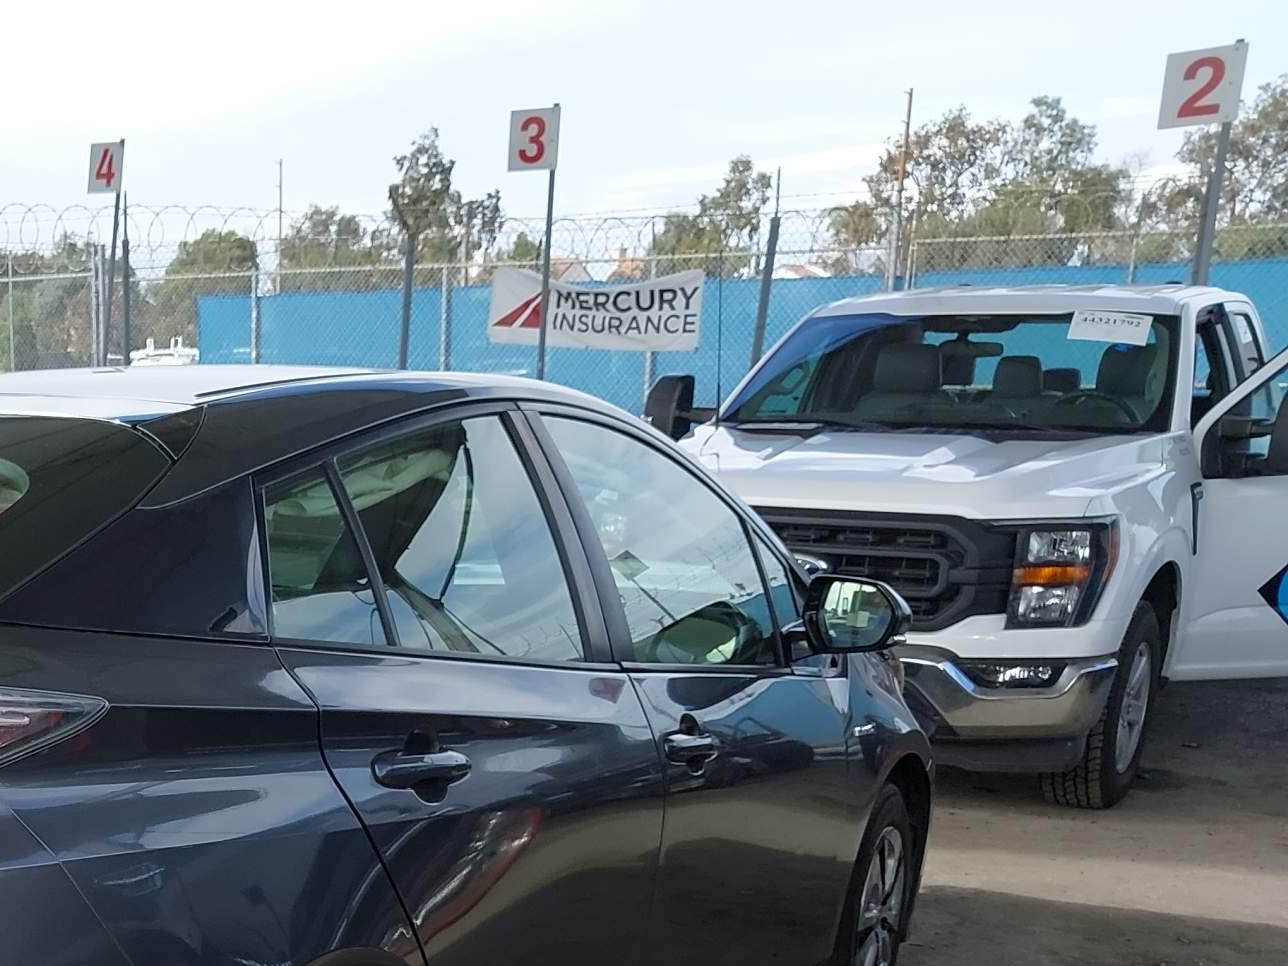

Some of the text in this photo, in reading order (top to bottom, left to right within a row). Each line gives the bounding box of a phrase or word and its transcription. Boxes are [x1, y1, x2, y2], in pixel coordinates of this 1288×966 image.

[1176, 56, 1225, 118] 2
[518, 115, 546, 164] 3
[95, 148, 115, 187] 4
[555, 286, 700, 313] MERCURY
[552, 313, 697, 335] INSURANCE
